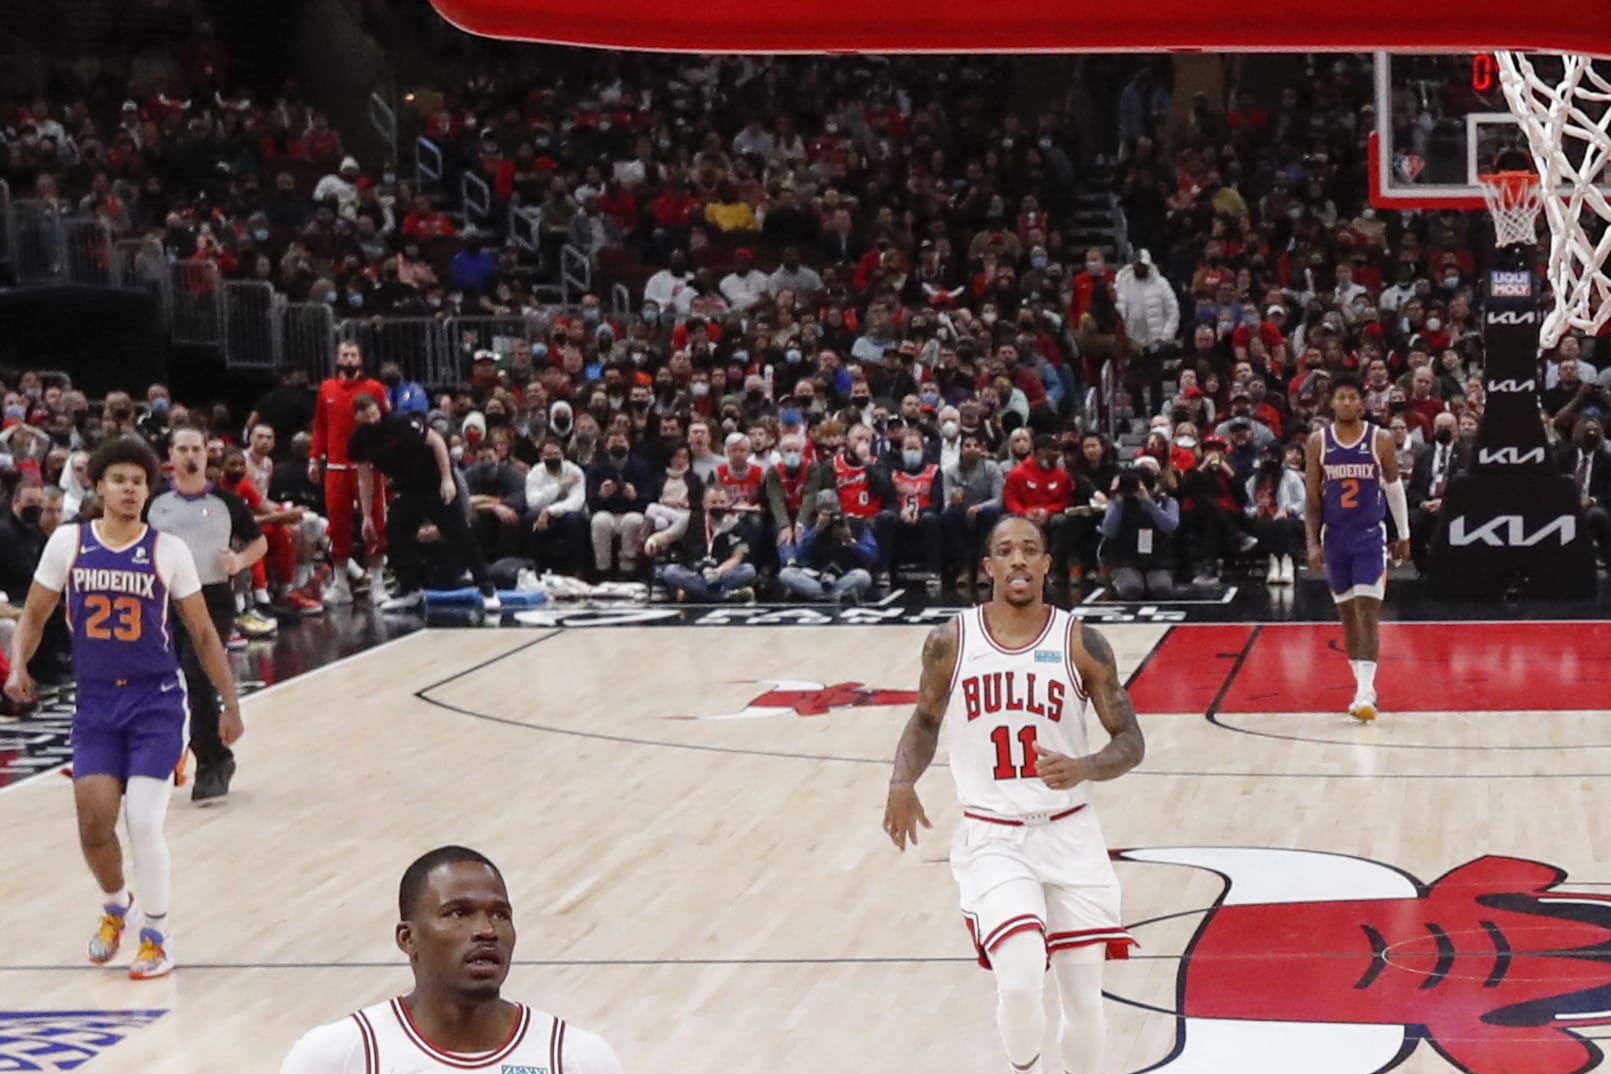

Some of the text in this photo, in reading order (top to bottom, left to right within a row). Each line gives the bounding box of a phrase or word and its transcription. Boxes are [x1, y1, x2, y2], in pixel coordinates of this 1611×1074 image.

[1494, 284, 1530, 295] MOLY
[1324, 463, 1374, 480] PHOENIX
[1341, 478, 1359, 508] 2
[1449, 515, 1576, 546] KIA
[73, 568, 155, 599] PHOENIX
[84, 594, 142, 641] 23
[962, 671, 1065, 722] BULLS
[990, 725, 1041, 780] 11
